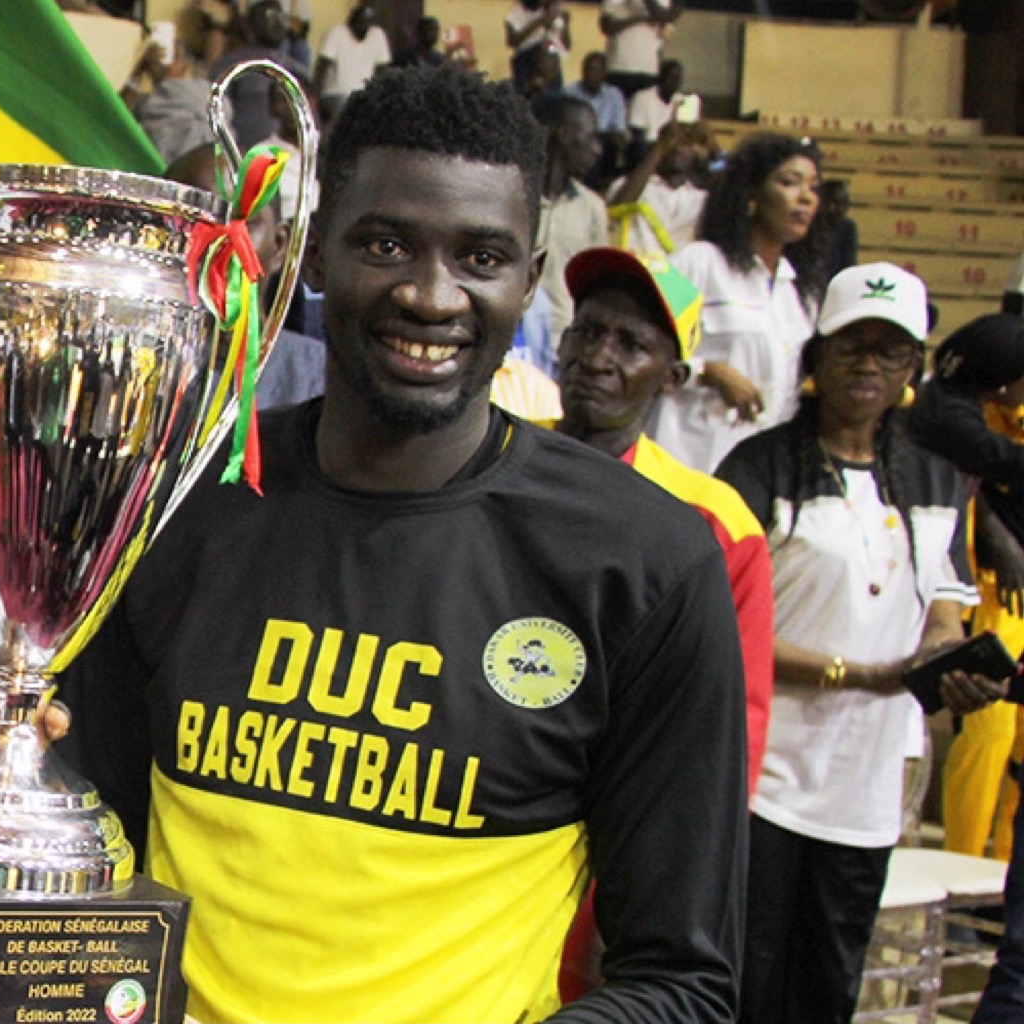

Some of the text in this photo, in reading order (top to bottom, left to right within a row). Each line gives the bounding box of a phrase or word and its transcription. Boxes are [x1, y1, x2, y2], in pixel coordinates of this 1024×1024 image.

[248, 618, 443, 731] DUC
[177, 700, 485, 830] BASKETBALL
[63, 917, 150, 933] SÉNÉGALAISE
[7, 941, 25, 954] DE
[86, 940, 118, 953] BALL
[20, 960, 66, 974] COUPE
[69, 960, 87, 974] DU
[90, 957, 150, 974] SÉNÉGAL
[28, 983, 85, 998] HOMME
[16, 1007, 97, 1023] Édition 2022
